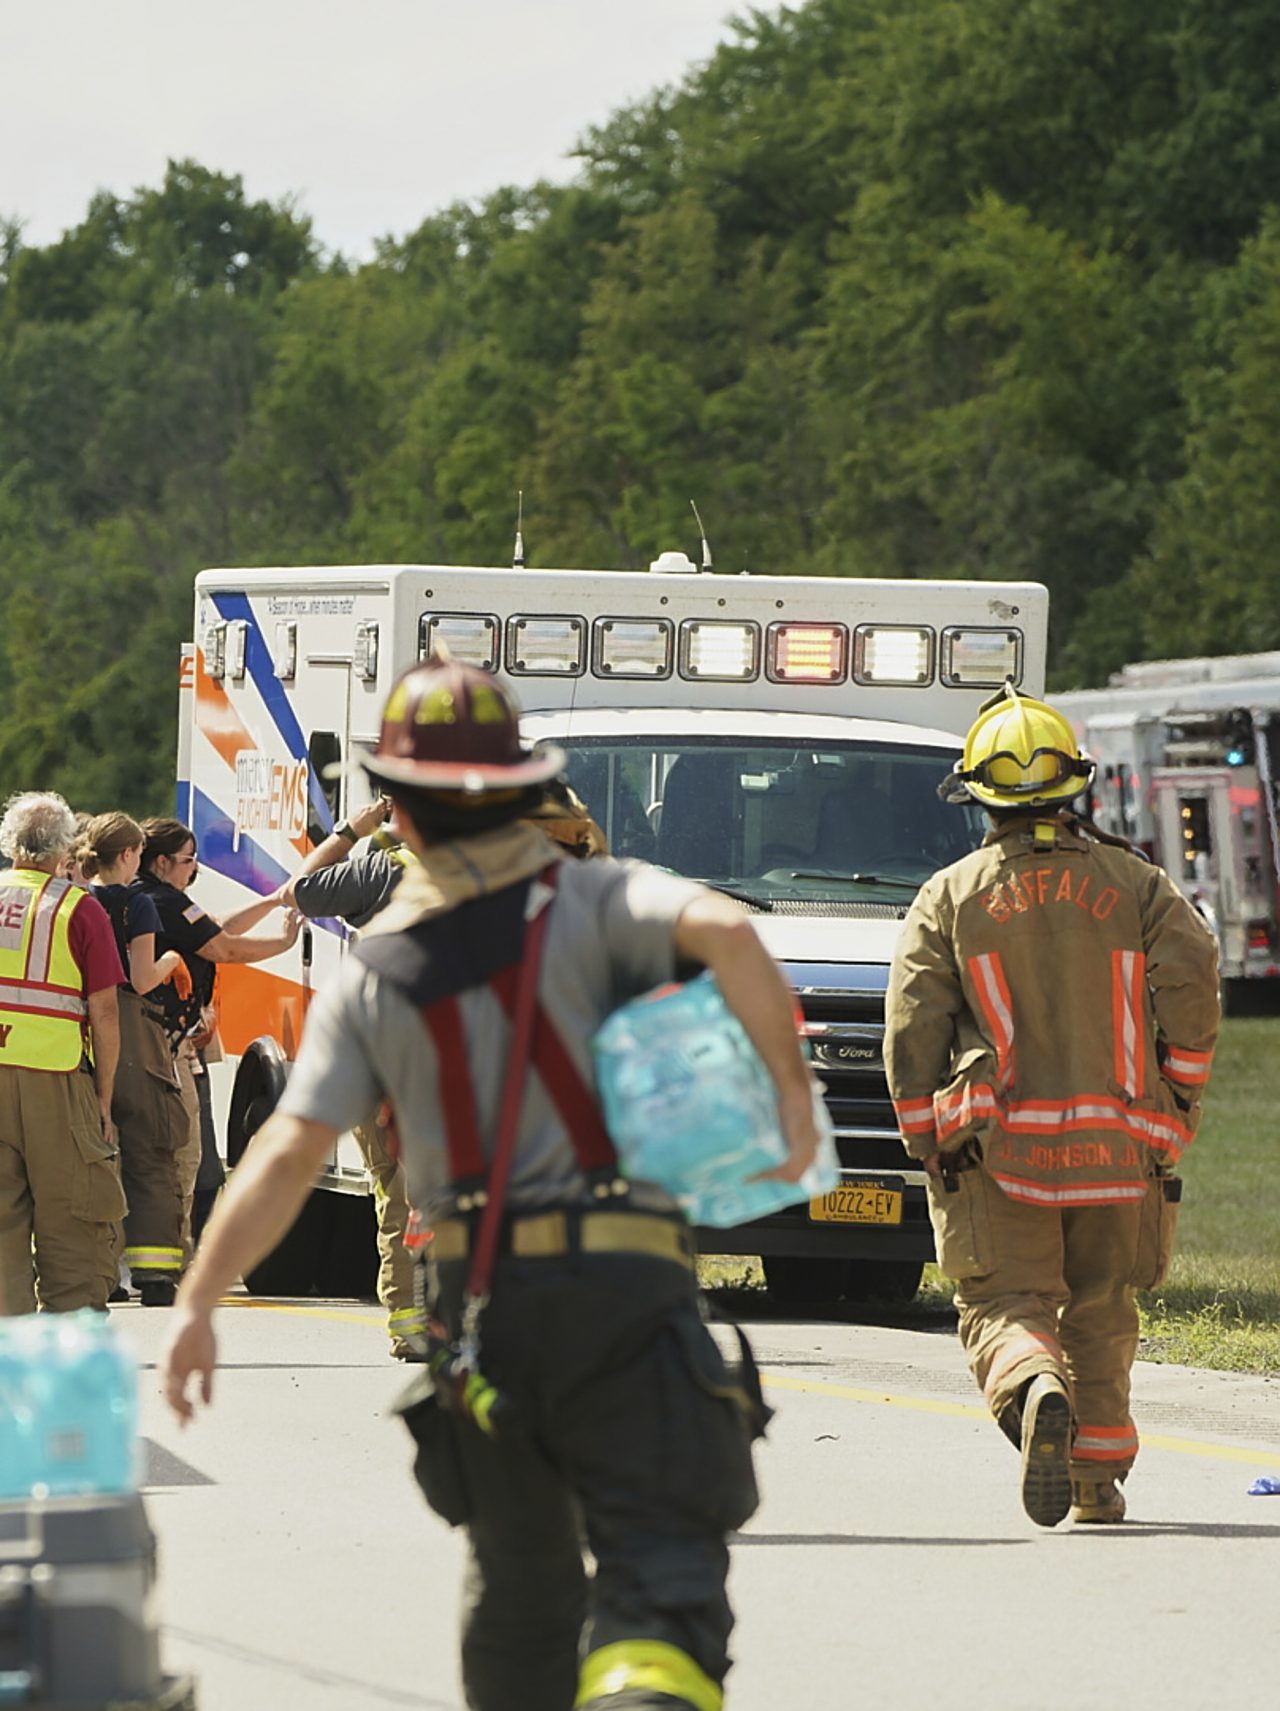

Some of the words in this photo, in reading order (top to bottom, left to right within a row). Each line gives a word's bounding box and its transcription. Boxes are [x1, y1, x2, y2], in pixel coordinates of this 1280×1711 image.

[269, 765, 307, 831] EMS
[978, 869, 1120, 924] BUFFALO
[838, 1045, 875, 1058] Ford
[1024, 1144, 1113, 1170] JOHNSON
